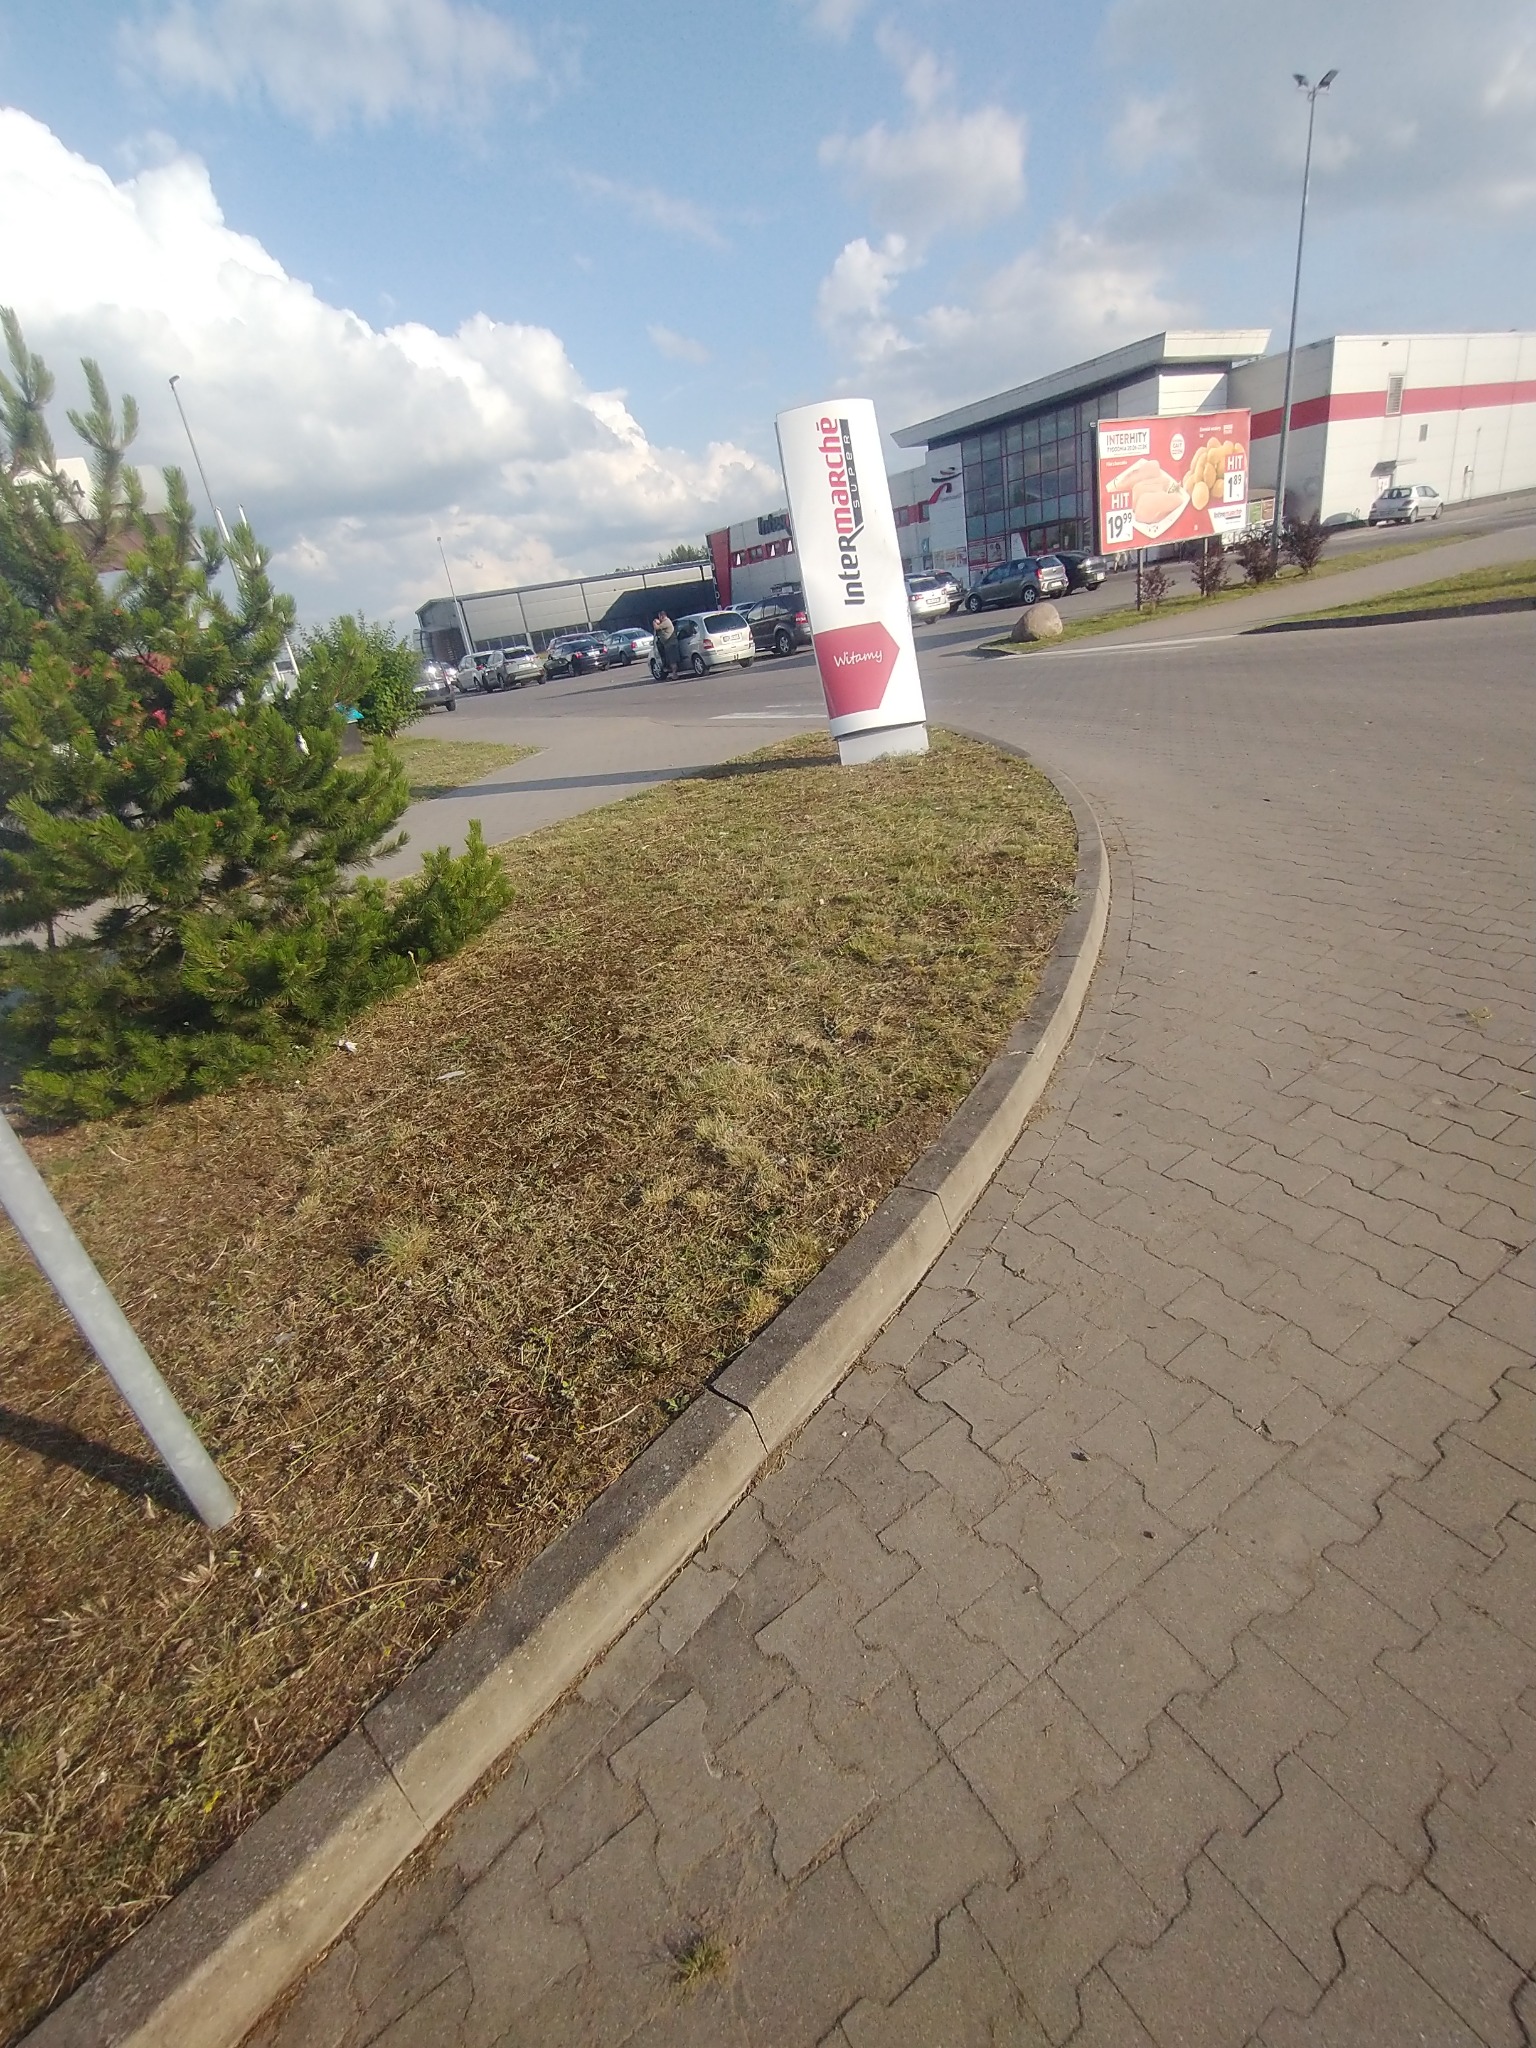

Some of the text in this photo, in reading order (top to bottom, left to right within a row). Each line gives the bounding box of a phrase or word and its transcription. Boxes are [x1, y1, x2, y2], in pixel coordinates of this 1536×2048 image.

[1106, 431, 1148, 446] INTERHITY
[1227, 455, 1244, 470] HIT
[1111, 492, 1130, 509] HIT
[833, 649, 883, 668] Witamy
